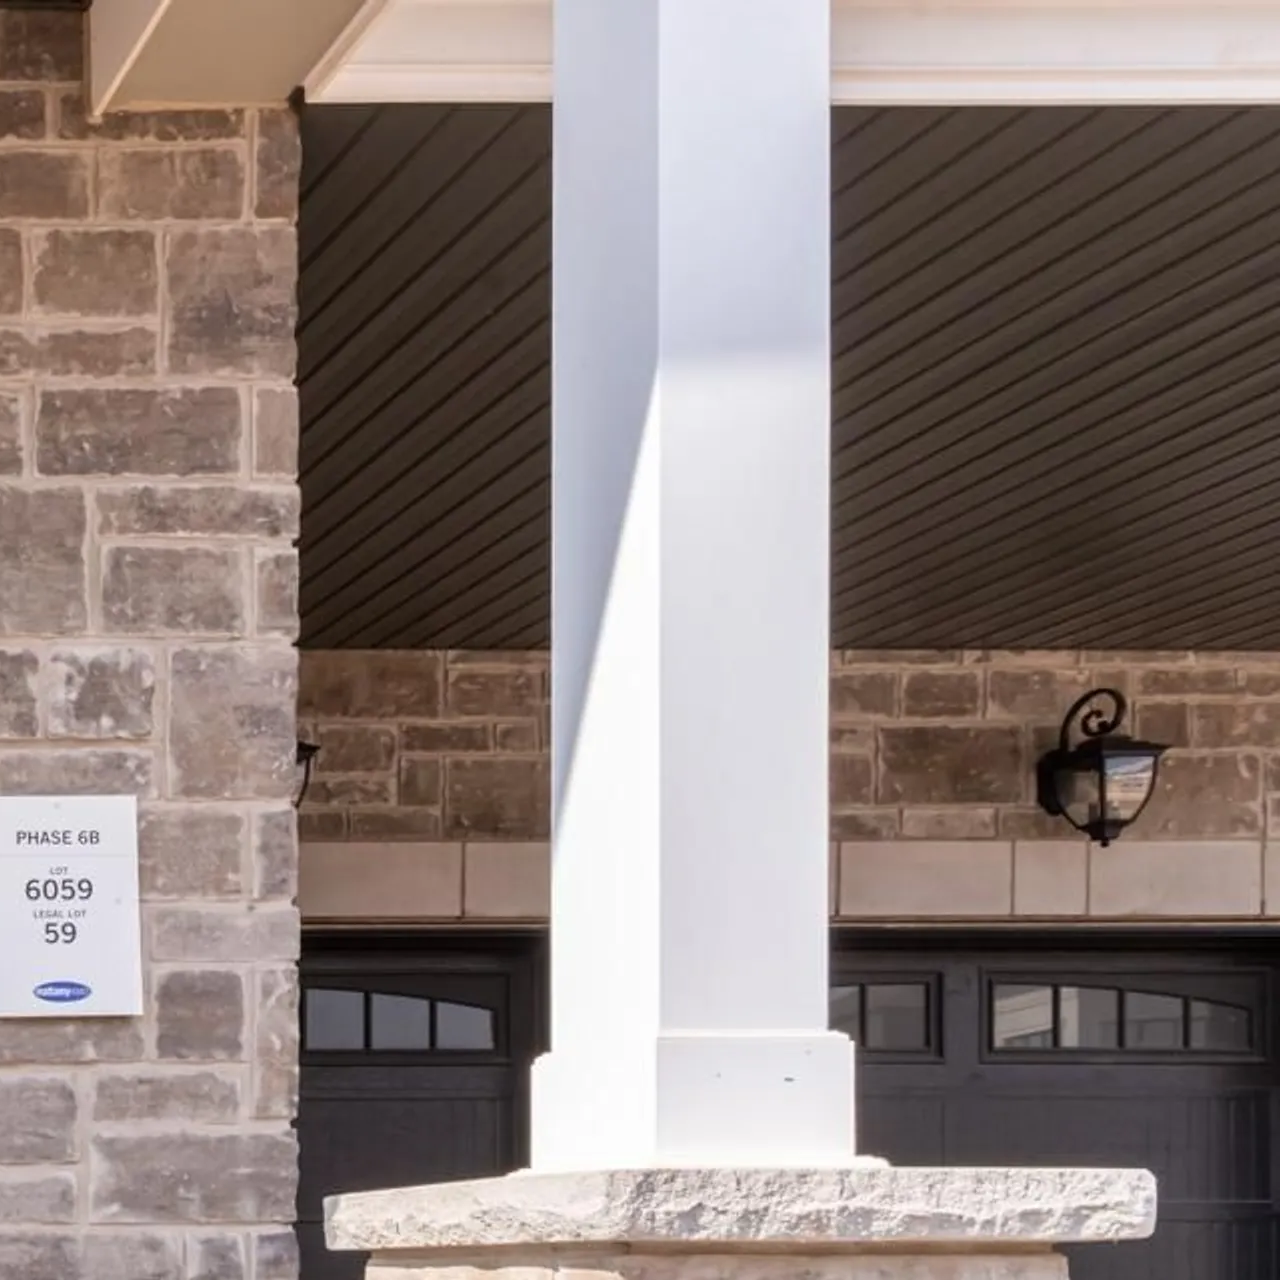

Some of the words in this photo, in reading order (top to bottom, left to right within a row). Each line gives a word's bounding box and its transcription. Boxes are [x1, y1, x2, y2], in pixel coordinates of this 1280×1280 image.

[16, 830, 72, 845] PHASE
[78, 830, 100, 845] 6B
[49, 866, 68, 875] LOT
[25, 878, 93, 900] 6059
[33, 910, 64, 919] LEGAL
[68, 910, 87, 919] LOT
[45, 922, 77, 944] 59
